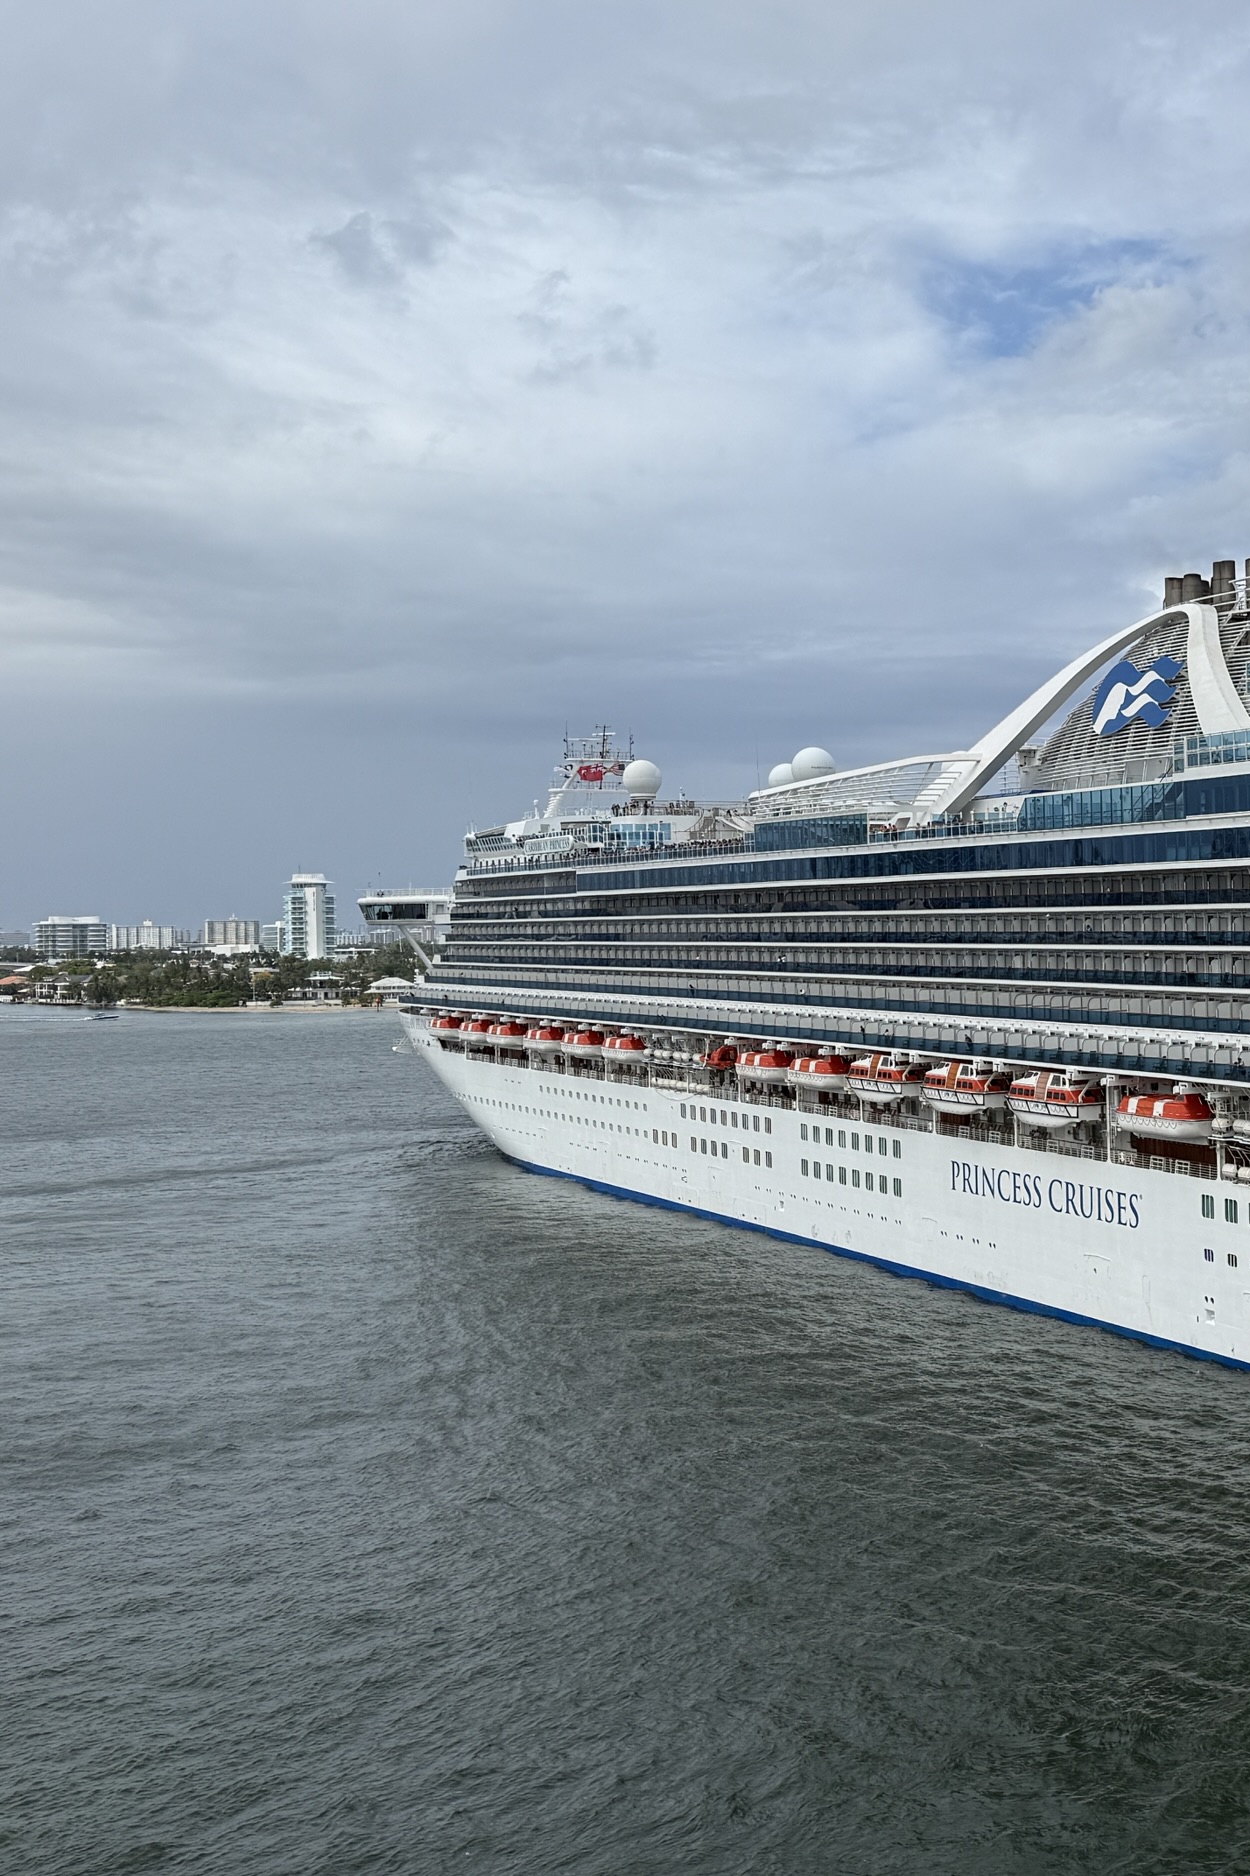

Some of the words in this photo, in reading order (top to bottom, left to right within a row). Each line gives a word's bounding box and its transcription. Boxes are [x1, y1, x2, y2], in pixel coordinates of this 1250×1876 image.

[525, 841, 548, 852] CARIBBEAN
[549, 838, 570, 849] PRINCESS
[950, 1160, 1042, 1208] PRINCESS
